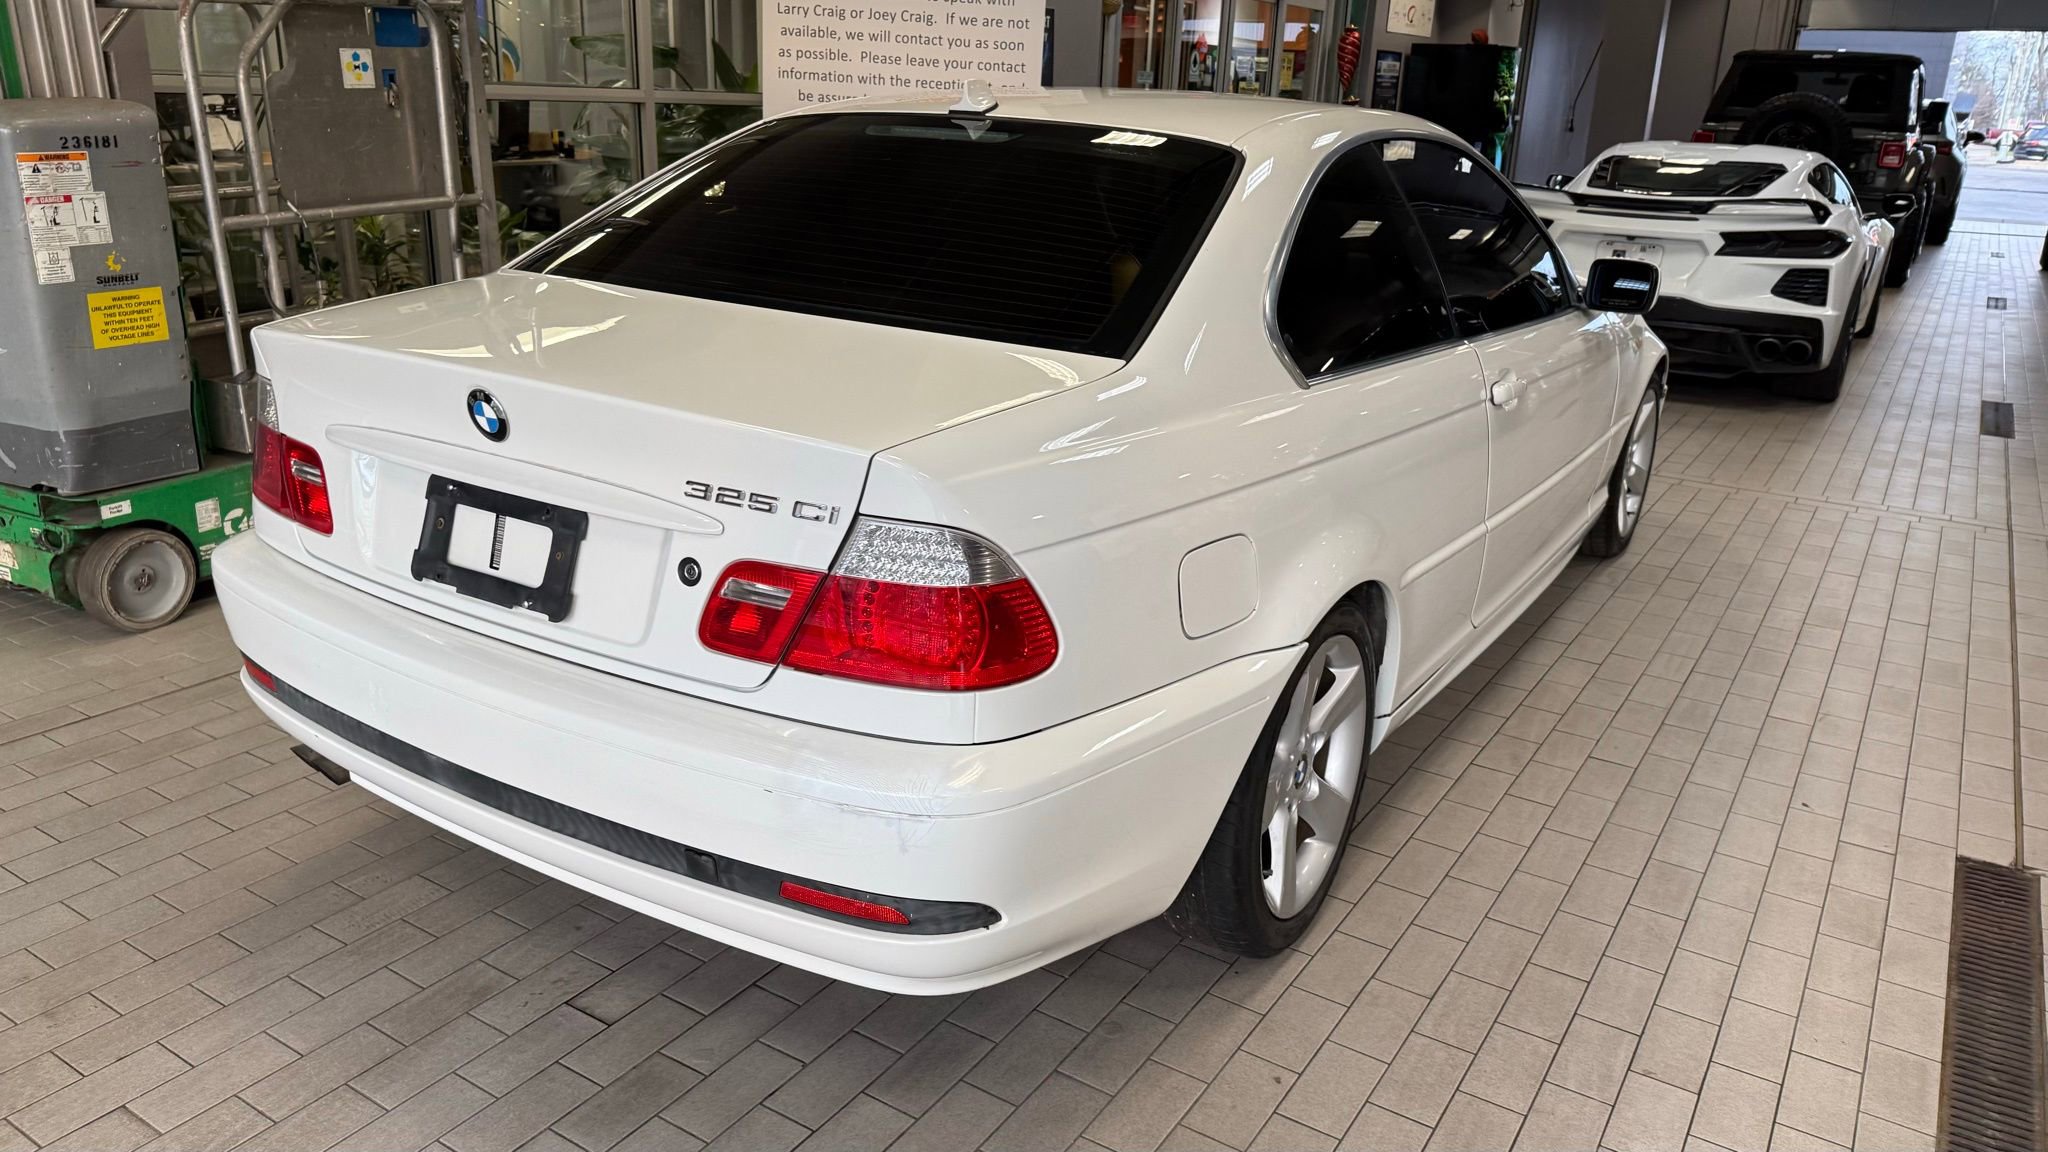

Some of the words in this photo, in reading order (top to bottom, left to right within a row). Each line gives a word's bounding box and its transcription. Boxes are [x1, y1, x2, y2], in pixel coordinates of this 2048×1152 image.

[777, 2, 810, 18] Larry
[813, 4, 846, 21] Craig
[850, 9, 865, 19] or
[867, 7, 897, 24] Joey
[900, 9, 937, 27] Craig.
[946, 12, 956, 25] If
[959, 16, 978, 26] we
[982, 17, 1003, 28] are
[1007, 18, 1030, 30] not
[780, 25, 841, 42] available,
[845, 31, 864, 41] we
[868, 30, 891, 43] will
[894, 33, 943, 46] contact
[947, 37, 971, 49] you
[975, 39, 989, 49] as
[993, 40, 1025, 51] soon
[778, 48, 792, 58] as
[796, 48, 852, 62] possible.
[860, 51, 902, 65] Please
[906, 53, 940, 68] leave
[943, 58, 973, 71] your
[977, 61, 1026, 74] contact
[778, 66, 853, 83] information
[857, 72, 886, 86] with
[889, 74, 911, 88] the
[798, 89, 814, 102] be
[59, 135, 119, 149] 236181
[96, 272, 140, 284] SUNBELT
[112, 294, 140, 302] WARNING
[91, 303, 125, 312] UNLAWFUL
[103, 311, 117, 319] THIS
[118, 308, 152, 317] EQUIPMENT
[104, 318, 126, 327] WITHIN
[111, 325, 145, 334] OVERHEAD
[108, 333, 136, 341] VOLTAGE
[684, 480, 780, 514] 325
[791, 500, 841, 525] Ci
